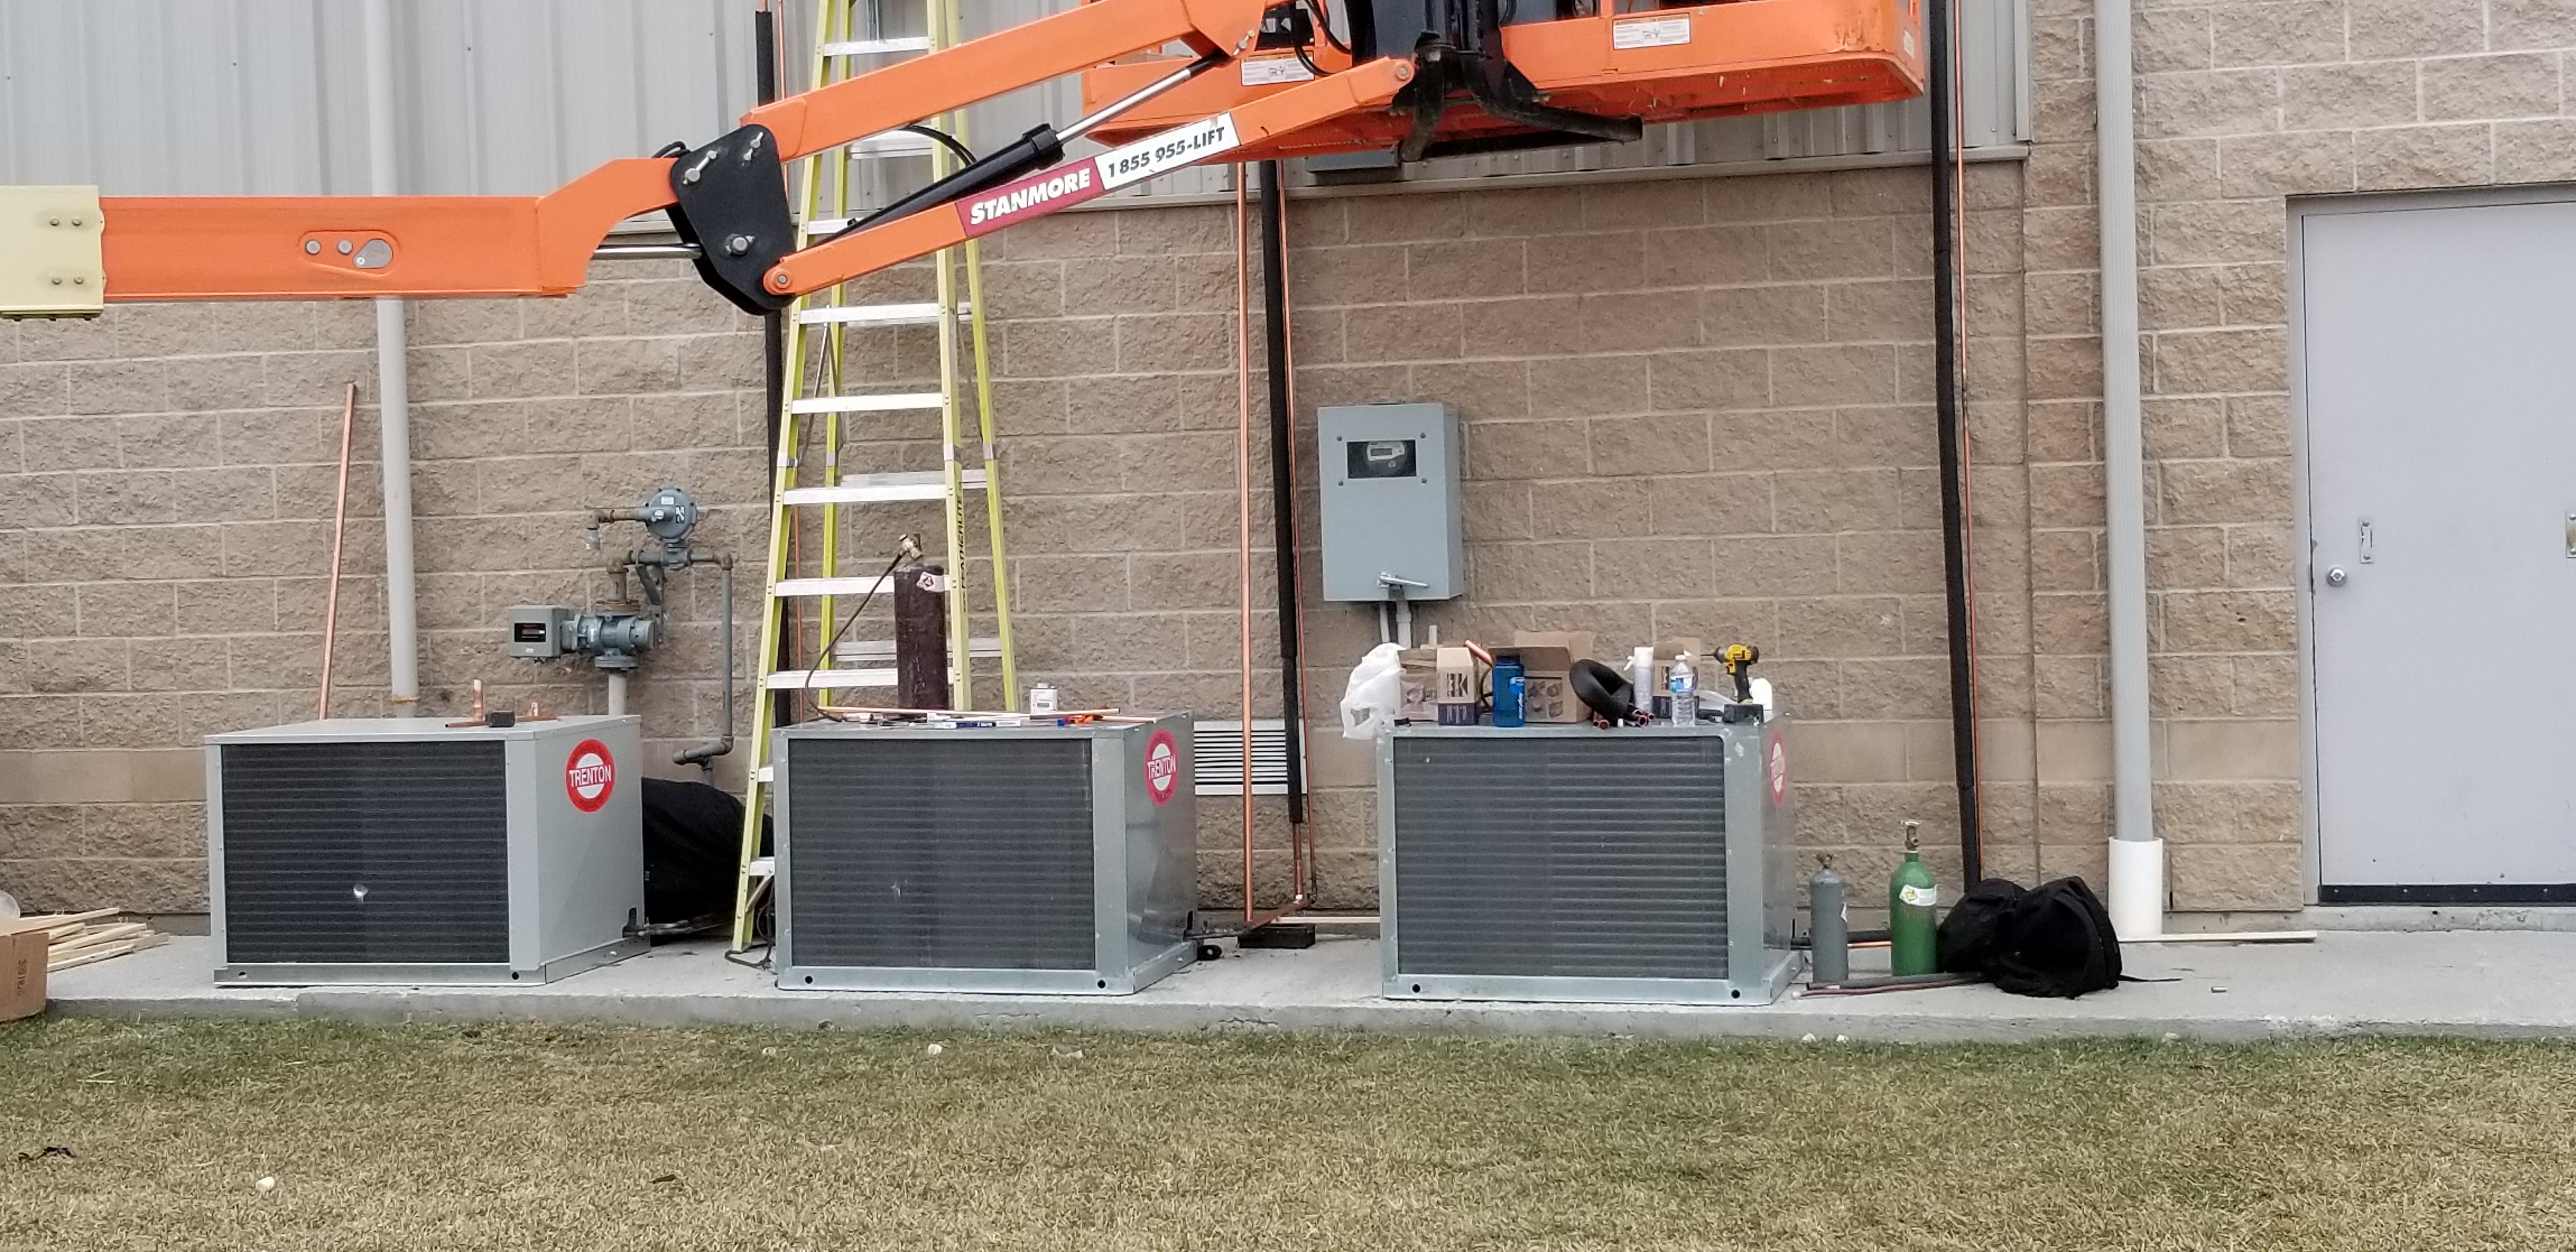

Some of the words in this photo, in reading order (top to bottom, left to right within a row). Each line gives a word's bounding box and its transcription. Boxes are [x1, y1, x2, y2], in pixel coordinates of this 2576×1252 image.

[1108, 163, 1116, 178] 1
[1119, 151, 1150, 174] 855
[1155, 126, 1225, 163] 955-LIFT
[970, 167, 1090, 225] STANMORE
[569, 764, 611, 788] TRENTON
